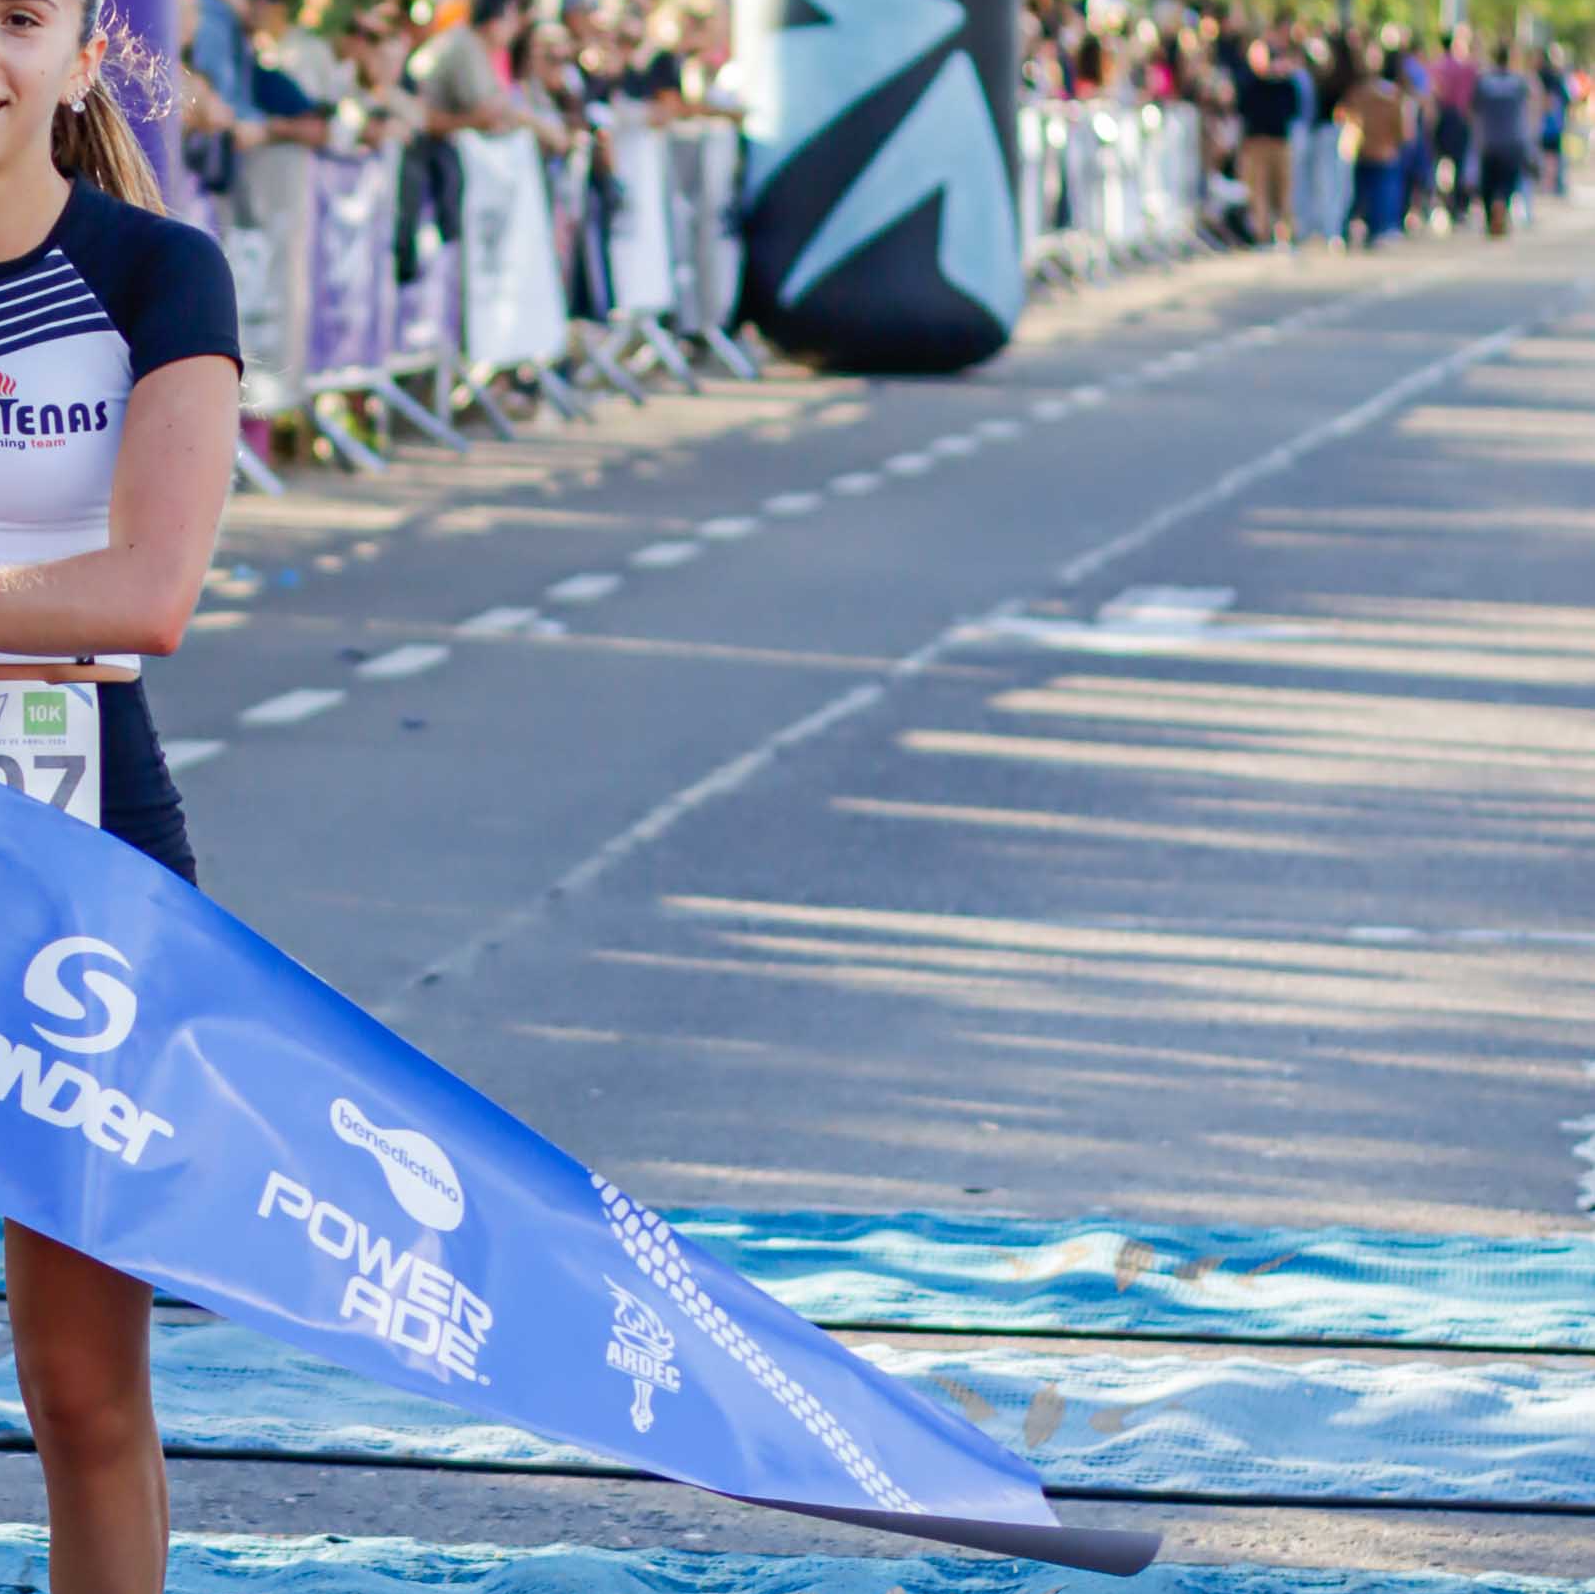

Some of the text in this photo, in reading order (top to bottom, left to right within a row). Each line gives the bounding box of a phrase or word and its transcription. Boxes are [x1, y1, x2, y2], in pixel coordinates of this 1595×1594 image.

[30, 438, 67, 449] team
[27, 704, 62, 723] 10K
[339, 1106, 459, 1203] benedictino
[257, 1170, 493, 1345] POWER
[606, 1340, 682, 1391] ARDEC
